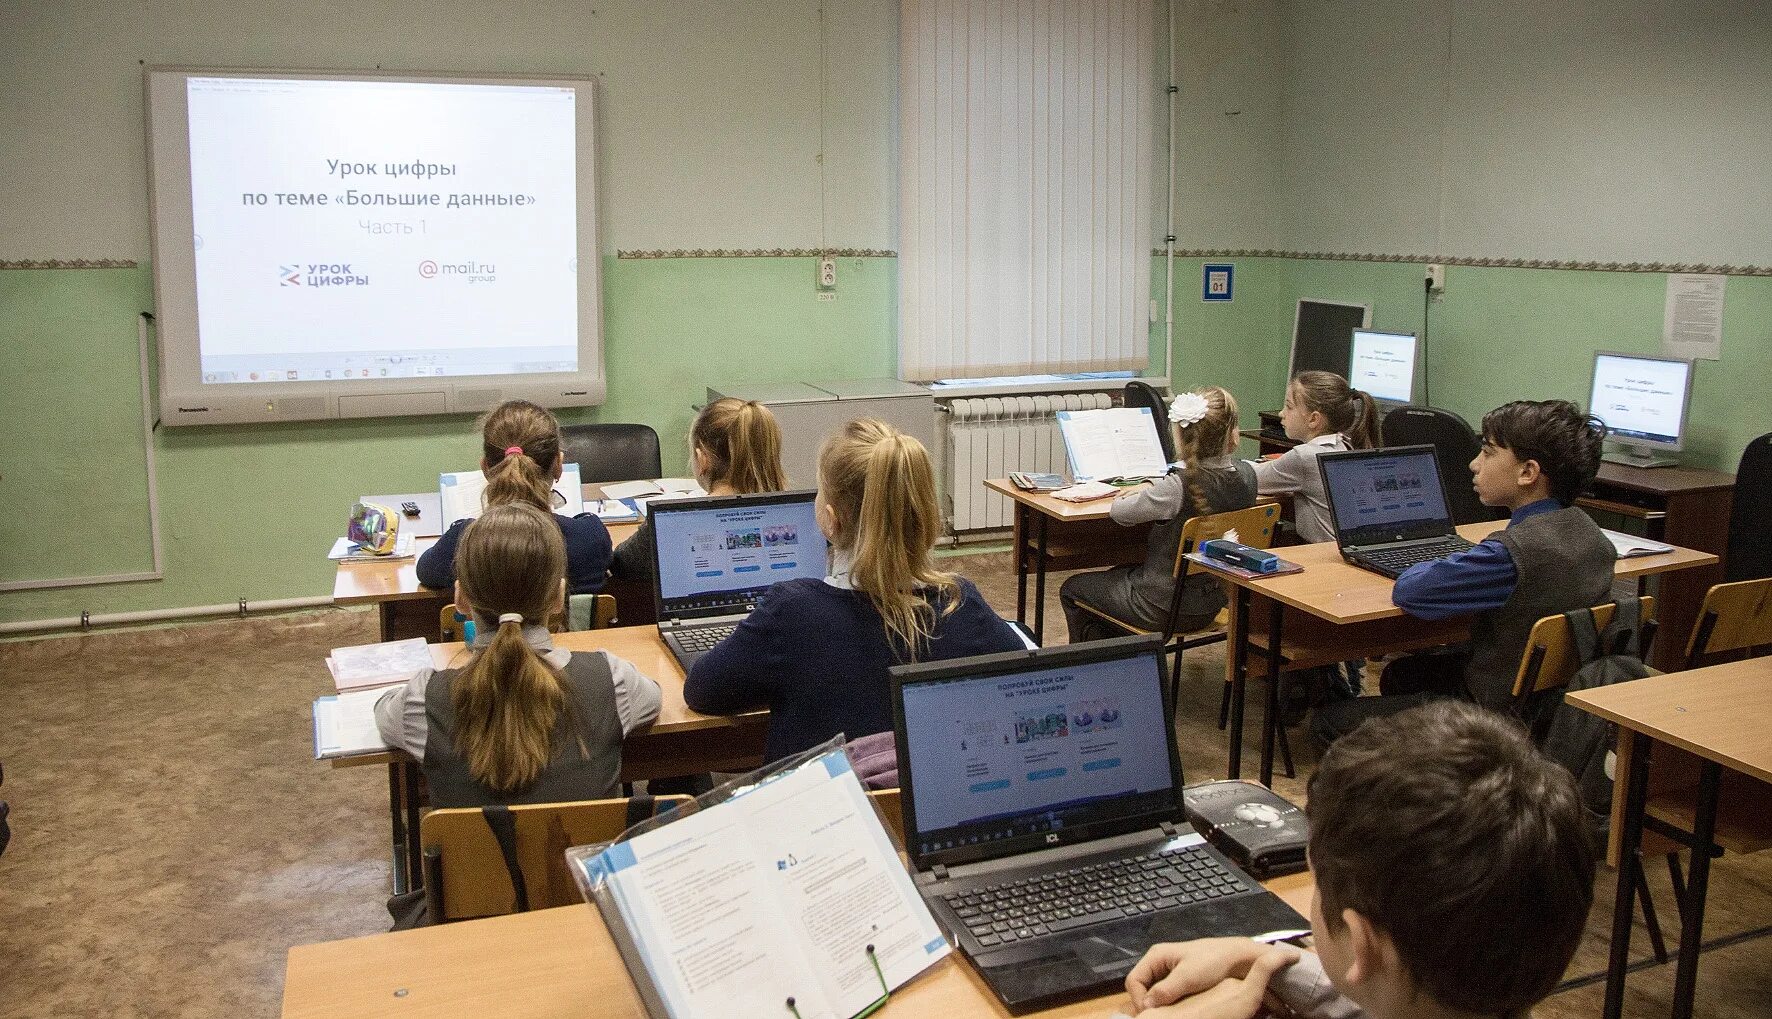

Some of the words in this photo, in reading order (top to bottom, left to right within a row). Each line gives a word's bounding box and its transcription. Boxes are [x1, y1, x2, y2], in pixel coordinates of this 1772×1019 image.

[327, 159, 378, 179] Урок
[385, 159, 456, 180] цифры
[242, 193, 268, 205] по
[274, 193, 328, 205] теме
[335, 190, 441, 206] «Большие
[446, 194, 536, 208] данные»
[358, 220, 413, 234] Часть
[421, 219, 427, 234] 1
[308, 264, 352, 274] УРОК
[442, 261, 495, 274] mail.ru
[307, 275, 369, 288] ЦИФРЫ
[468, 275, 496, 284] group
[1213, 282, 1224, 292] 01
